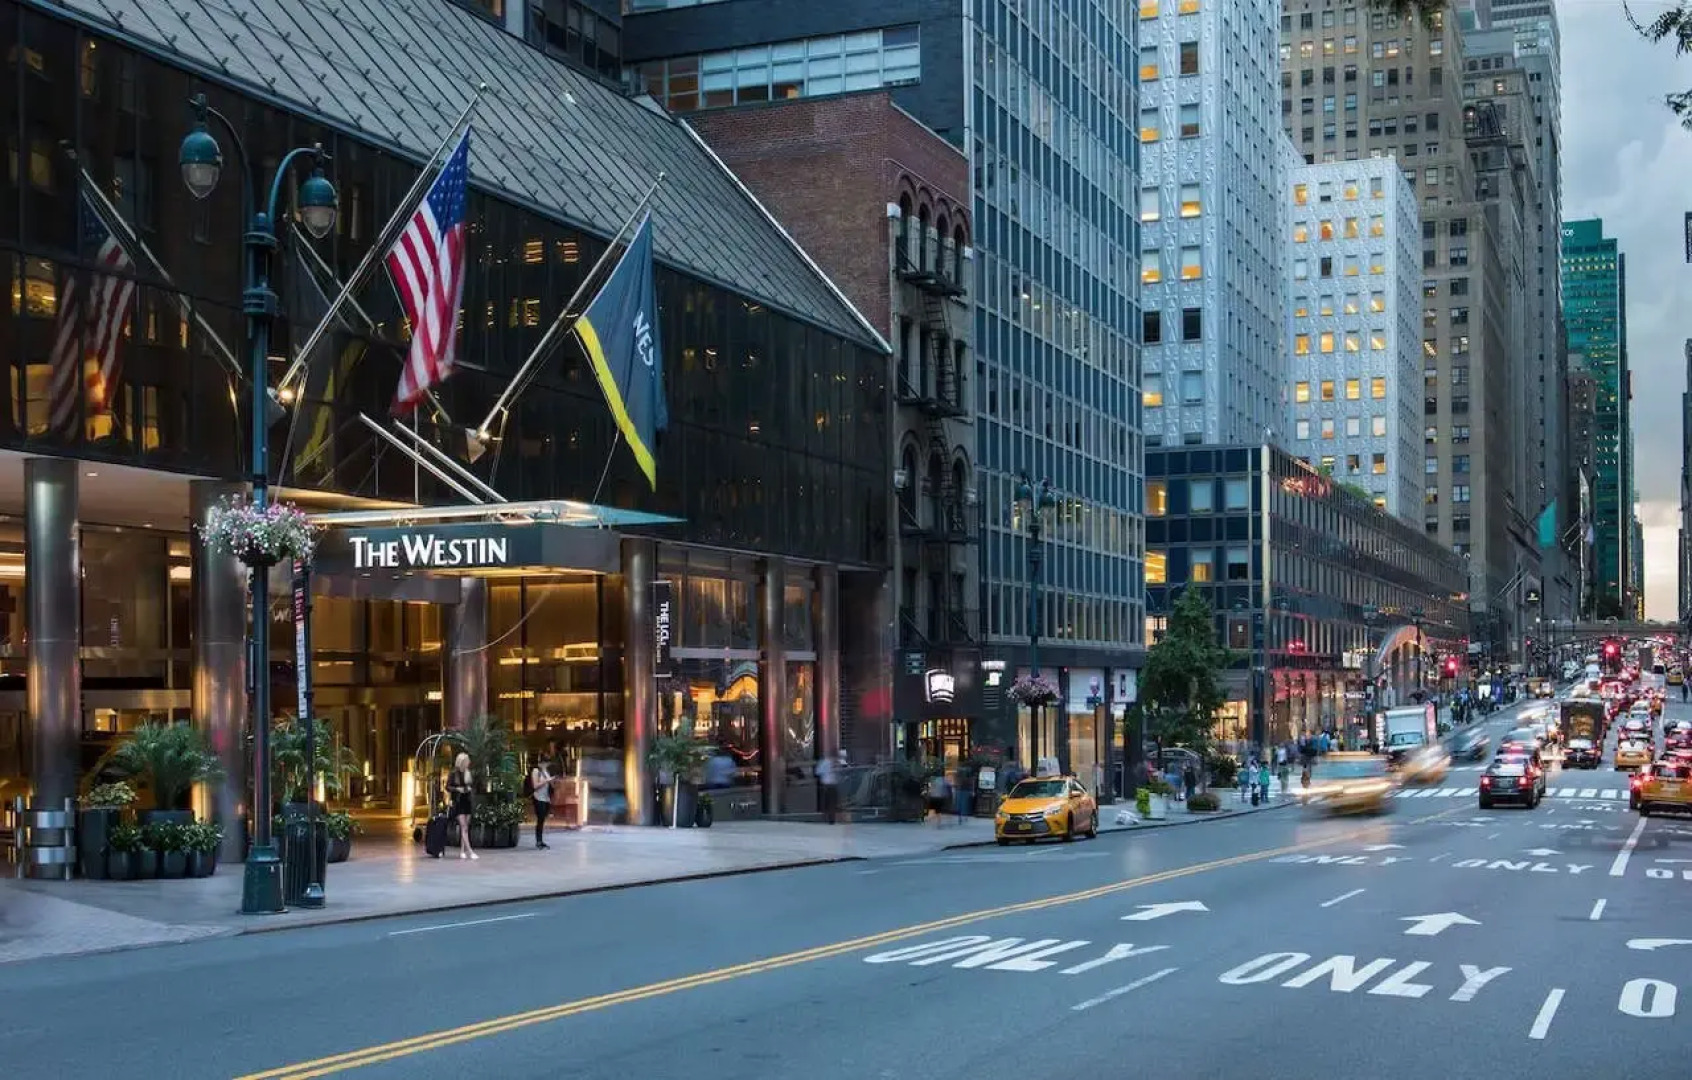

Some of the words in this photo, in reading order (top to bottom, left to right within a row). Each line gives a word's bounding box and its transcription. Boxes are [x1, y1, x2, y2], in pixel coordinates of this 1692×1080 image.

[349, 537, 399, 568] THE
[401, 534, 507, 565] WESTIN
[660, 601, 669, 623] THE
[1452, 859, 1594, 874] ONLY
[863, 936, 1171, 974] ONLY
[1218, 952, 1513, 1001] ONLY
